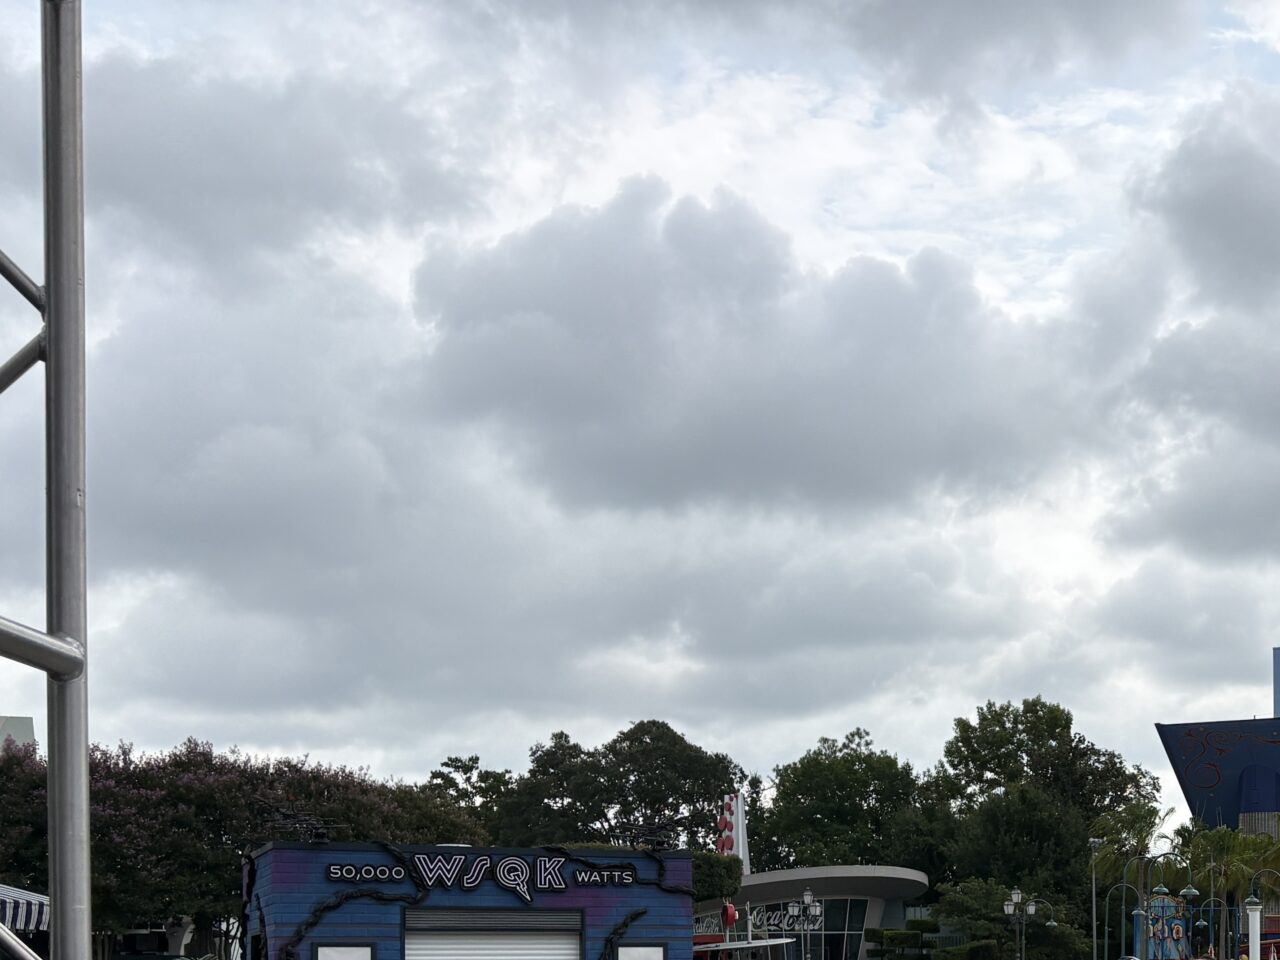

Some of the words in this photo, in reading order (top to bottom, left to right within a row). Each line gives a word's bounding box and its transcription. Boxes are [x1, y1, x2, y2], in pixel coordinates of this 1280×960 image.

[329, 864, 405, 881] 50,000
[414, 855, 566, 902] WSQK
[576, 870, 633, 884] WATTS
